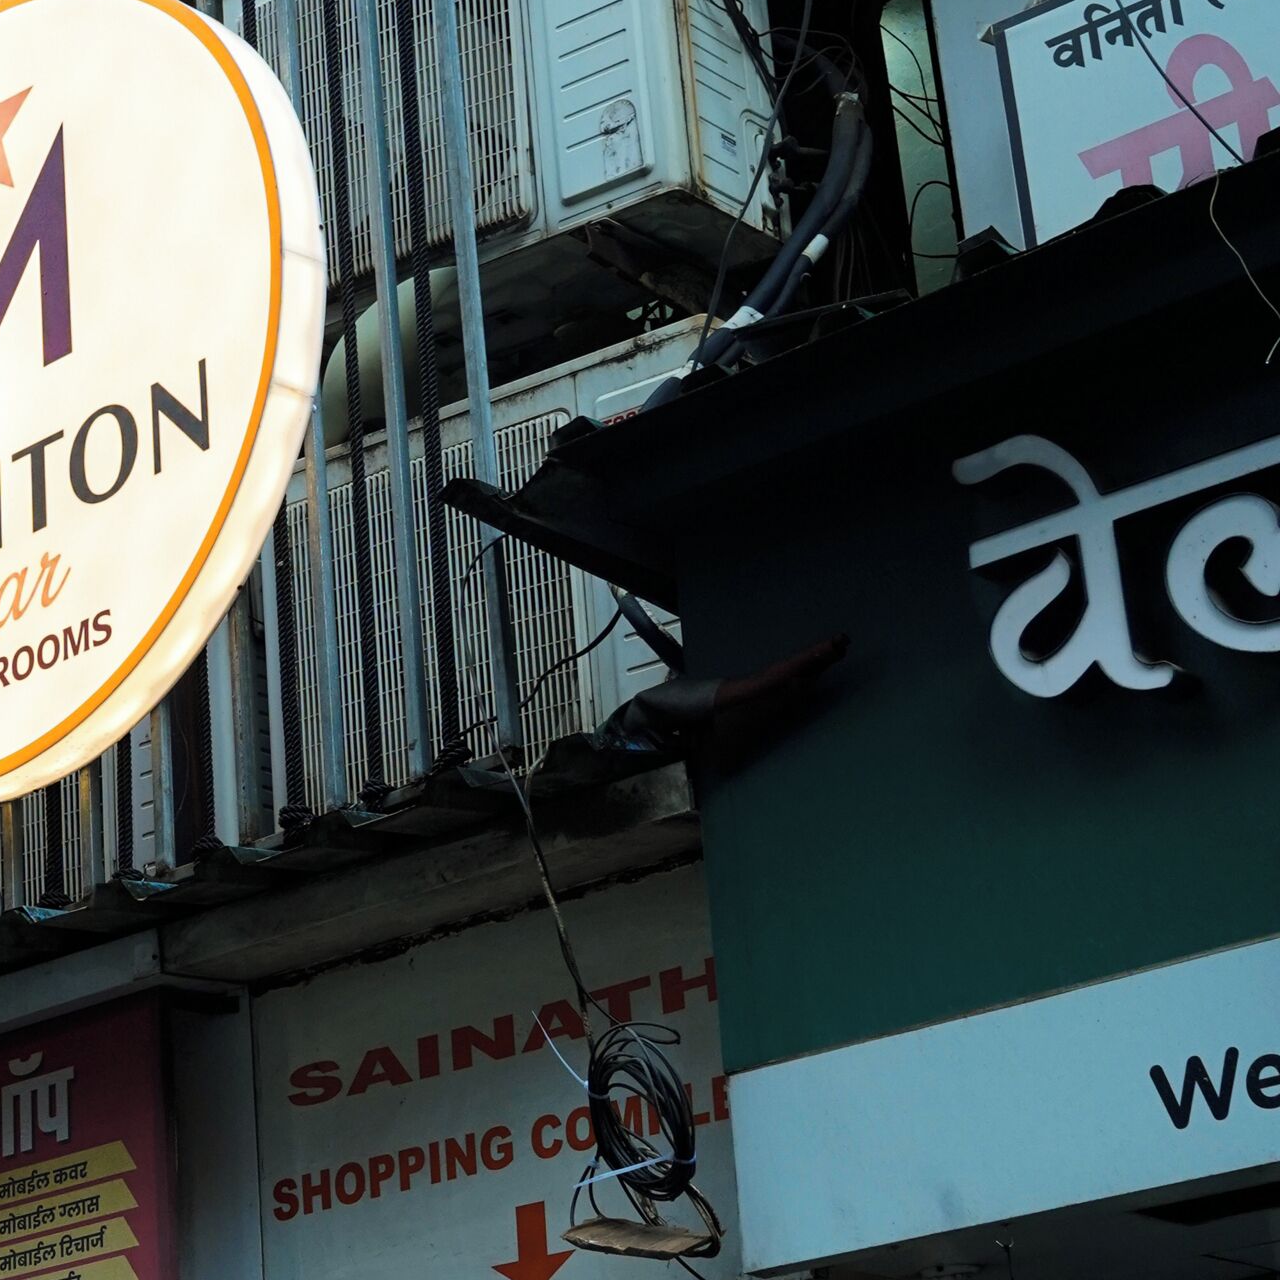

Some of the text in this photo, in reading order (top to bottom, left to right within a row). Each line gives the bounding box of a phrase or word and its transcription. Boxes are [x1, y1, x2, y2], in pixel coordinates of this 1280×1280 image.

[287, 956, 718, 1108] SAINATH
[53, 1160, 88, 1185] कवर
[271, 1122, 516, 1223] SHOPPING
[59, 1194, 101, 1219] ग्लास
[59, 1225, 108, 1258] रिचार्ज
